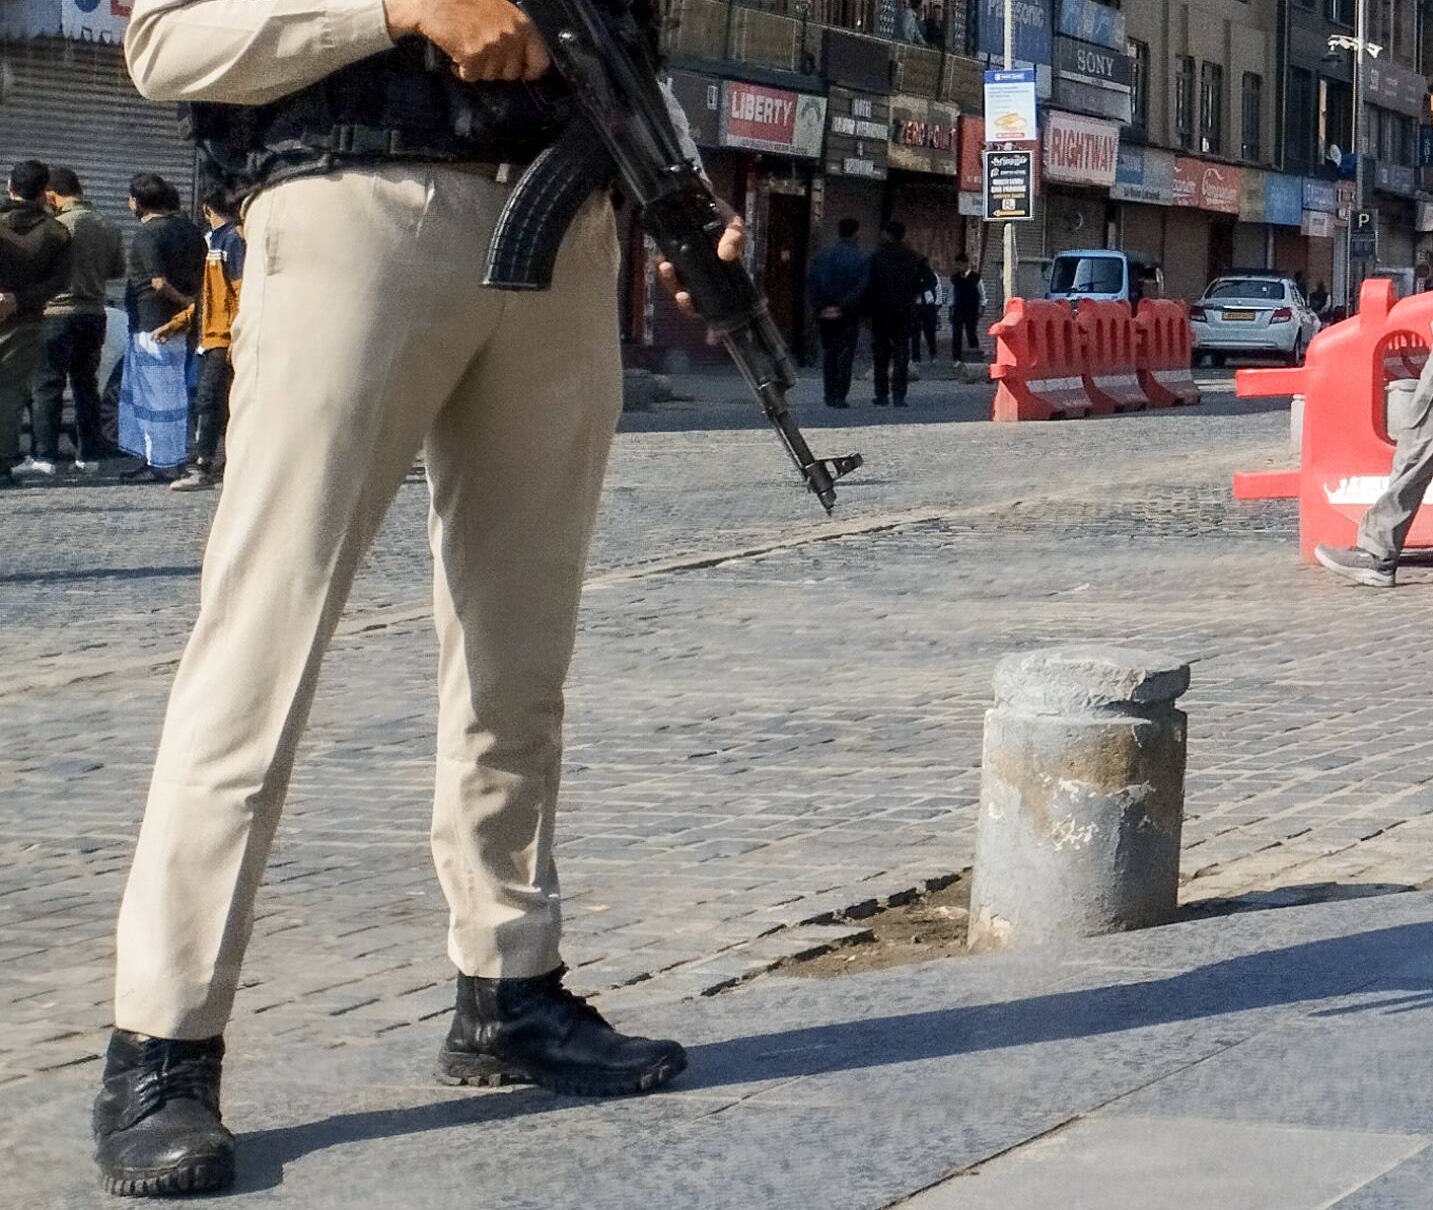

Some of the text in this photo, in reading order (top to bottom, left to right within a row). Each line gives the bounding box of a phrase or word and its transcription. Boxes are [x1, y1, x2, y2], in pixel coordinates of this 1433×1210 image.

[1076, 47, 1115, 77] SONY
[731, 91, 792, 127] LIBERTY
[1051, 126, 1116, 173] RIGHTWAY
[1358, 213, 1370, 228] P
